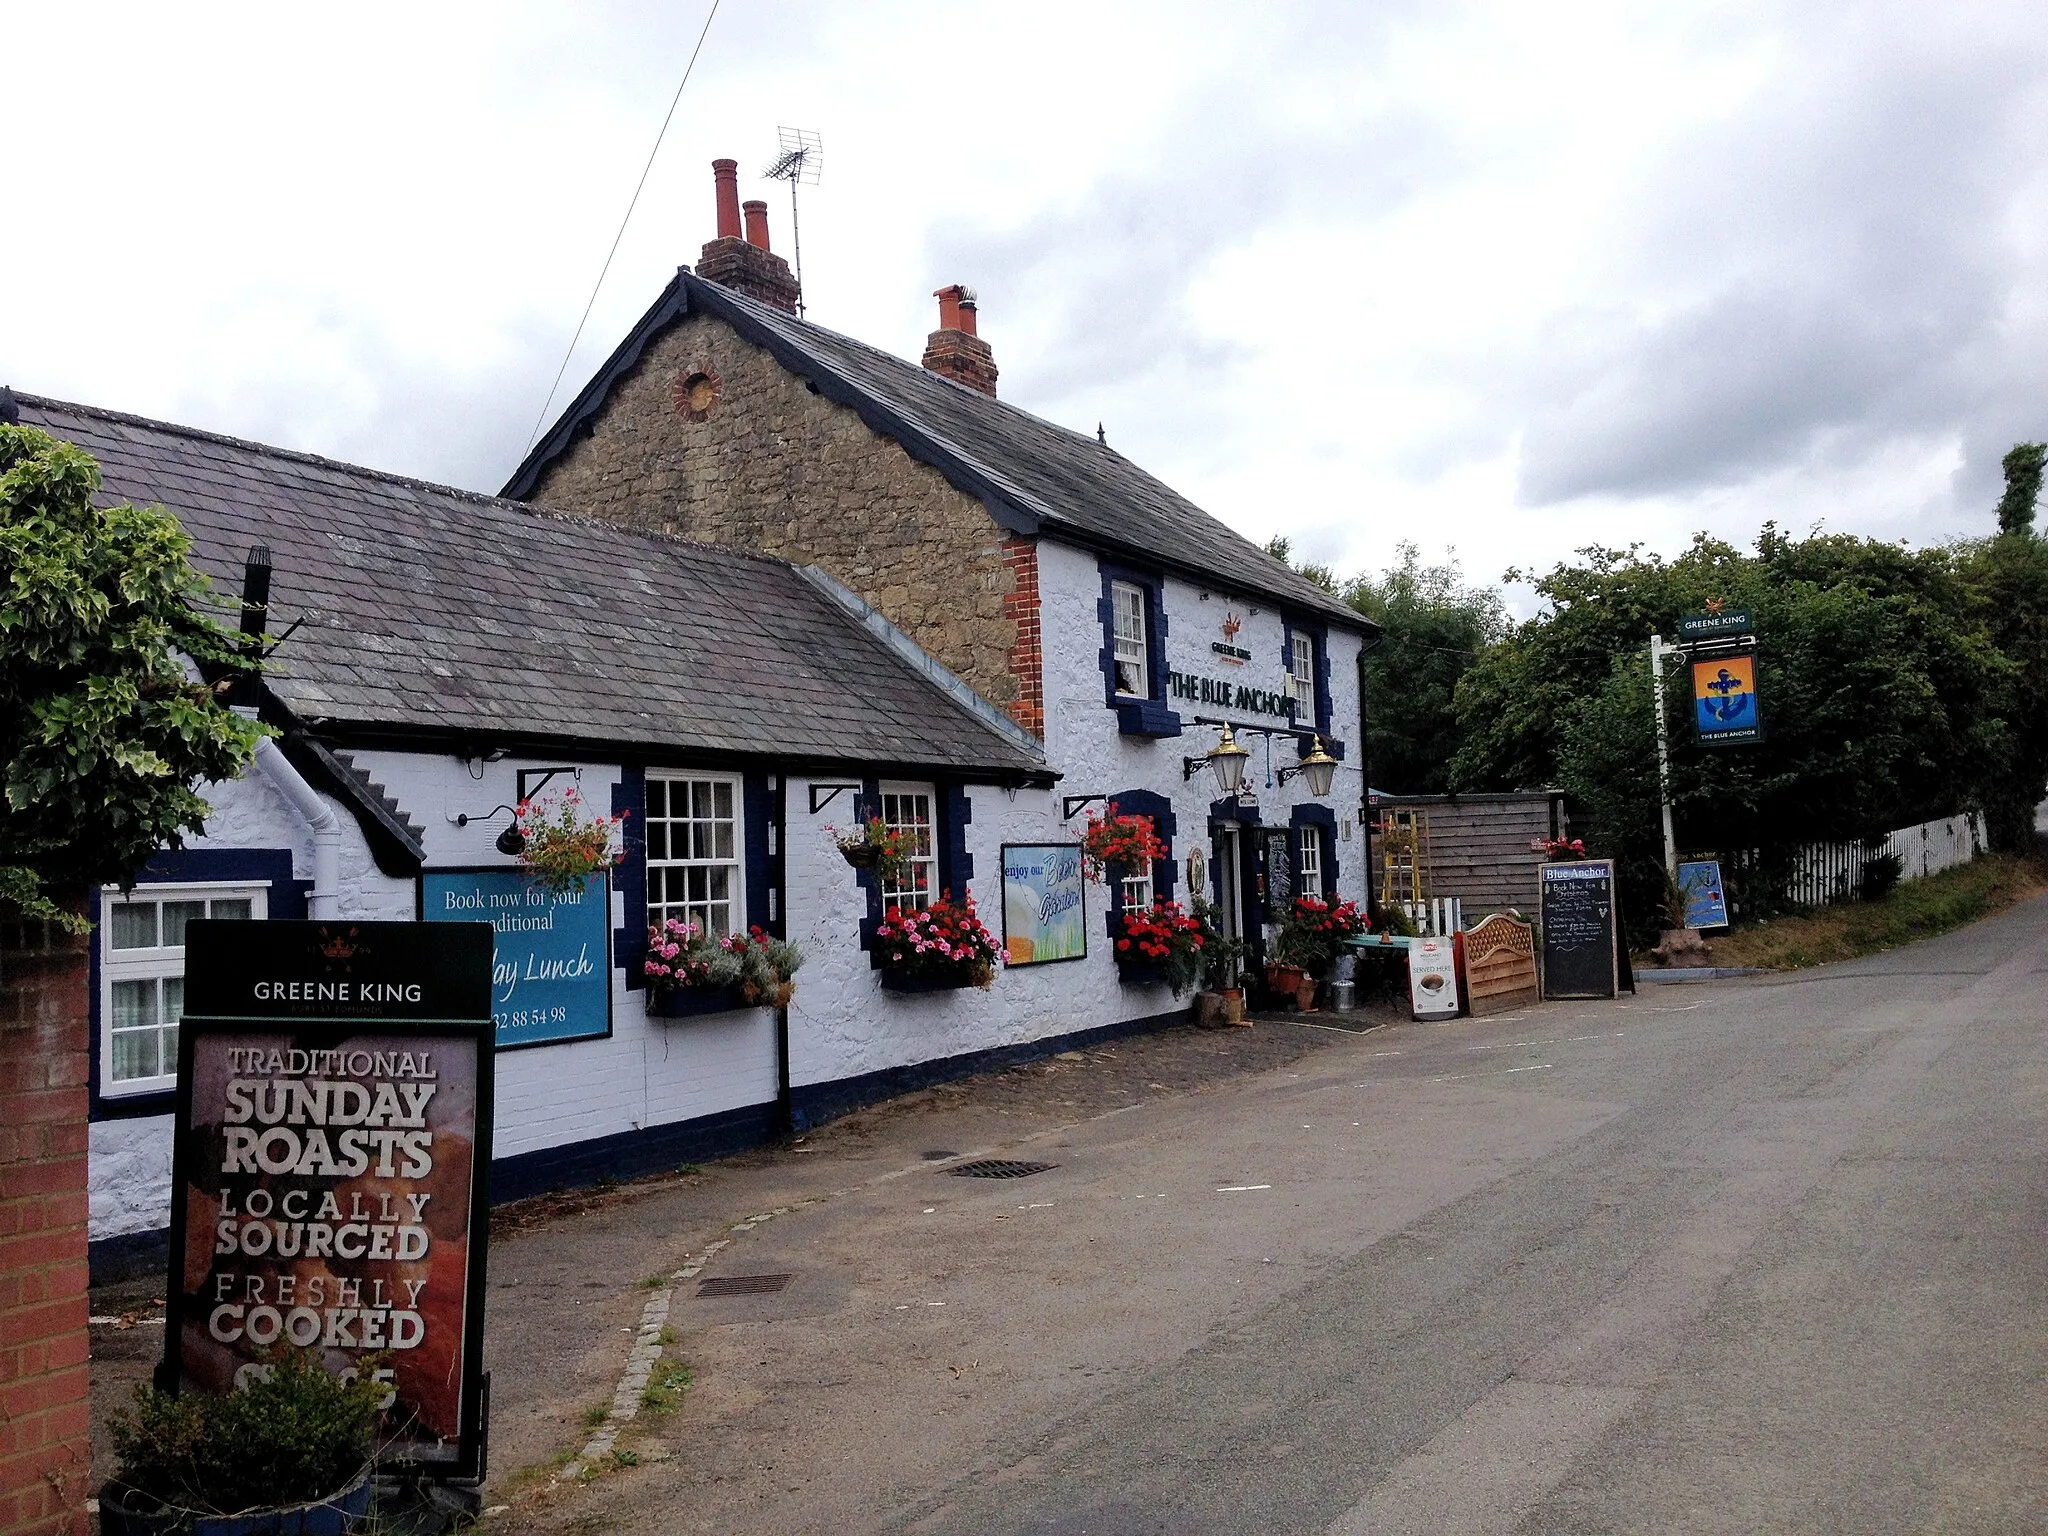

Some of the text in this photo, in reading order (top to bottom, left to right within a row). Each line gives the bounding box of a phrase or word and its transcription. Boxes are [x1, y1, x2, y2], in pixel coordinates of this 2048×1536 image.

[1685, 617, 1719, 630] GREENE
[1722, 615, 1746, 626] KING
[1168, 671, 1292, 719] THE BLUE ANCHOR
[1729, 729, 1756, 738] ANCHOR
[1005, 853, 1079, 887] enjoy our Beer
[1547, 867, 1606, 880] Blue Anchor
[445, 887, 583, 911] Book now for your
[524, 942, 594, 981] Lunch
[1413, 965, 1452, 974] SERVED HERE
[254, 981, 422, 1003] GREENE KING
[512, 1010, 528, 1028] 88
[531, 1008, 547, 1025] 54
[550, 1006, 566, 1024] 98
[228, 1047, 437, 1079] TRADITIONAL
[223, 1078, 437, 1128] SUNDAY
[221, 1126, 433, 1180] ROASTS
[218, 1188, 432, 1223] LOCALLY
[215, 1221, 430, 1261] SOURCED
[214, 1273, 427, 1309] FRESHLY
[208, 1303, 426, 1350] COOKED
